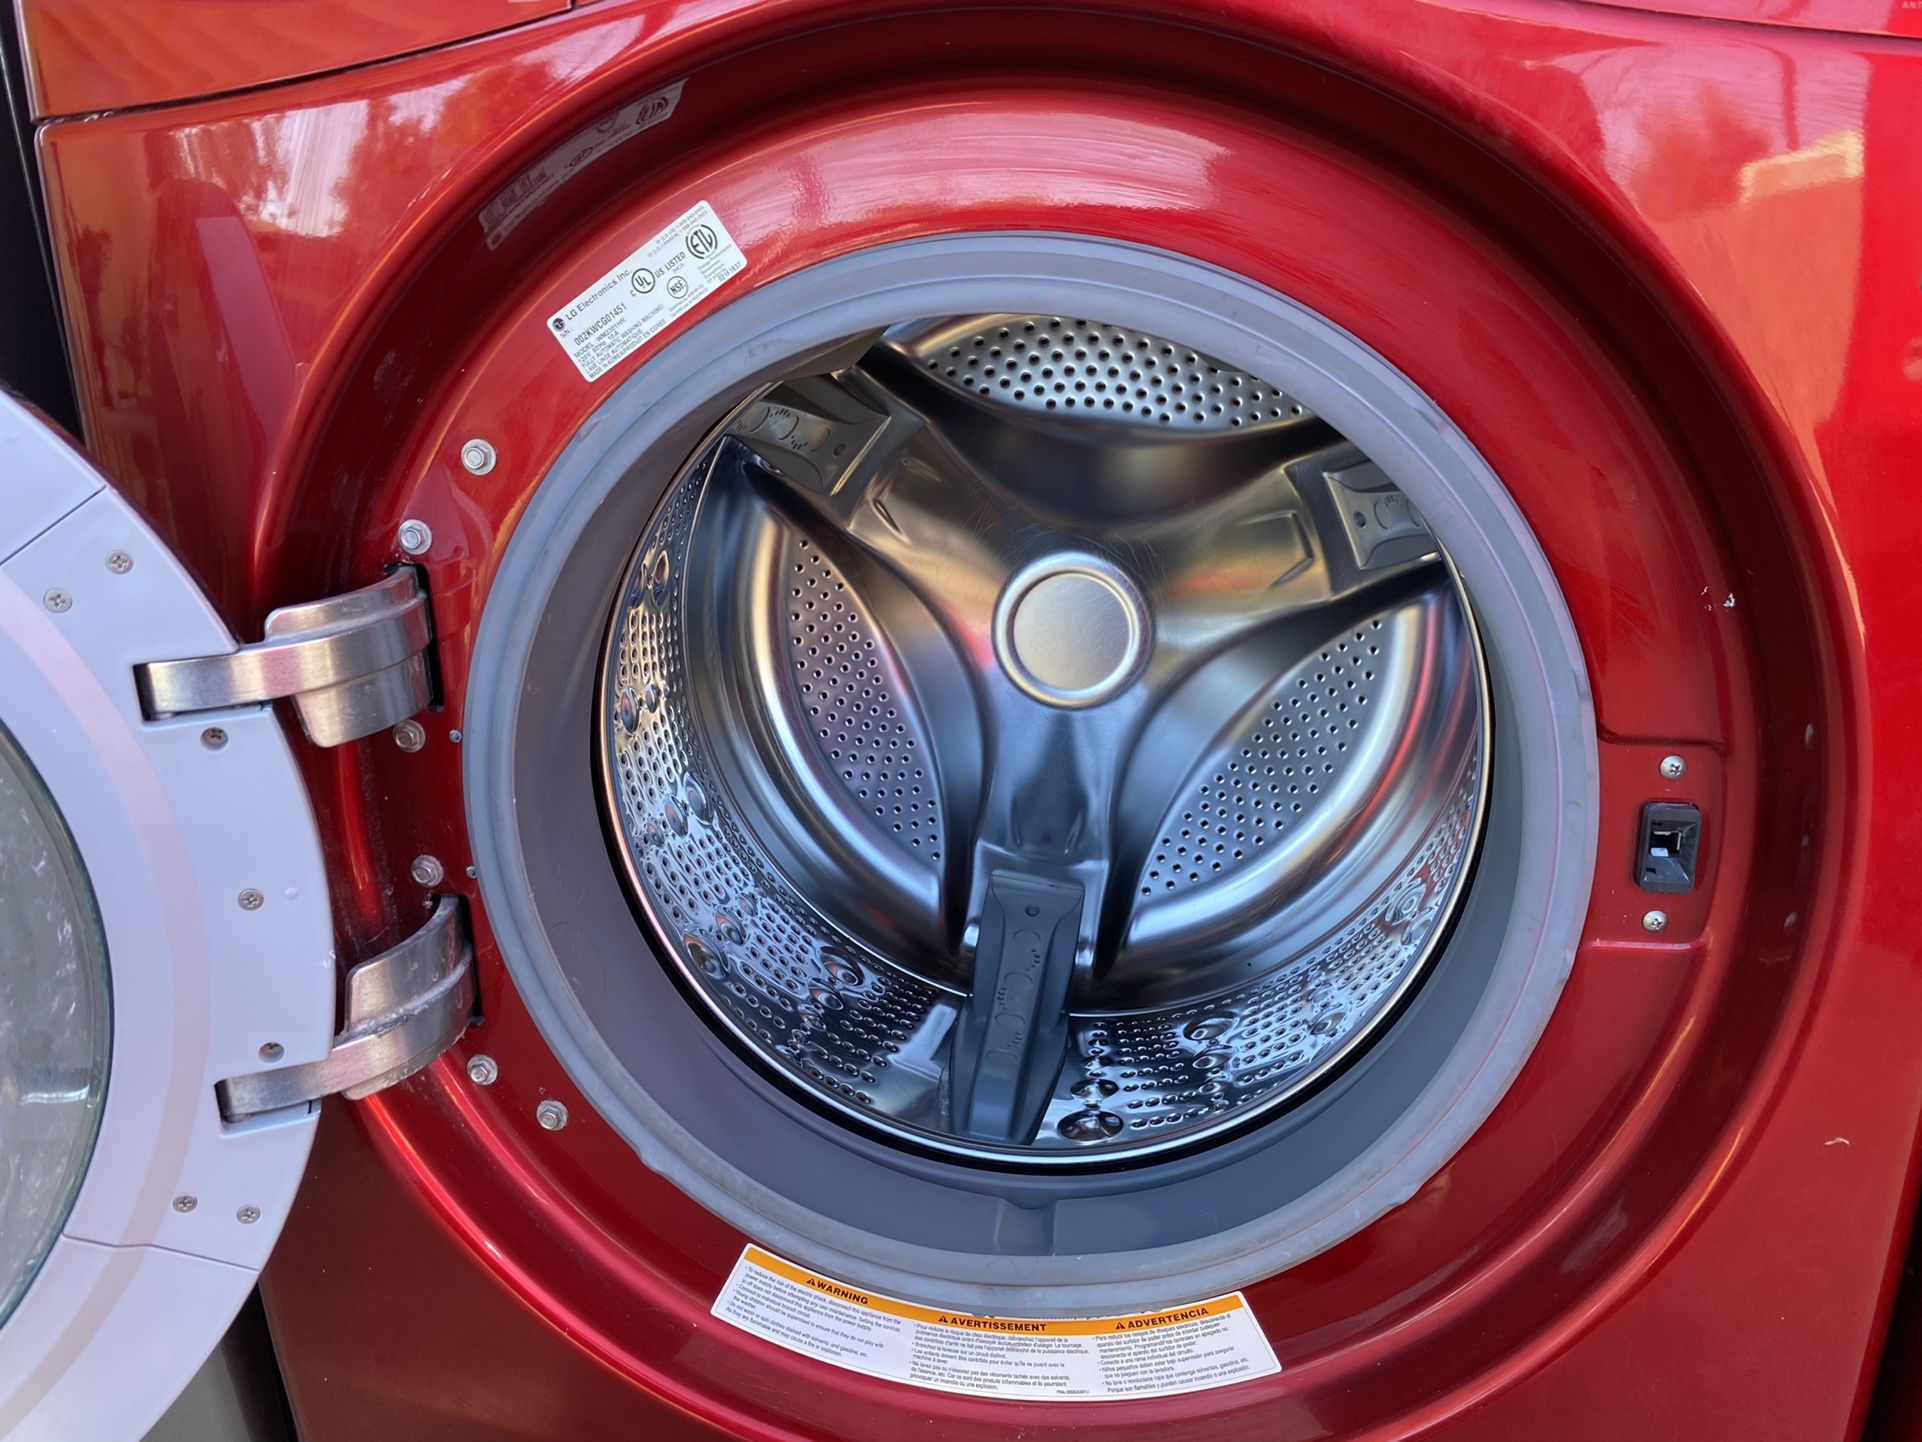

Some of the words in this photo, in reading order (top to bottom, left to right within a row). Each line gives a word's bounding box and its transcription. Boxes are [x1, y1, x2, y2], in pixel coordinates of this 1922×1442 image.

[654, 267, 666, 279] US
[664, 251, 687, 271] LISTED
[635, 275, 652, 287] UL
[565, 308, 578, 321] LG
[576, 278, 618, 312] Electronics
[616, 267, 633, 282] Inc.
[573, 302, 627, 346] 002KWCG01451
[816, 1281, 869, 1306] WARNING
[951, 1317, 1047, 1332] AVERTISSEMENT
[1127, 1307, 1209, 1329] ADVERTENCIA
